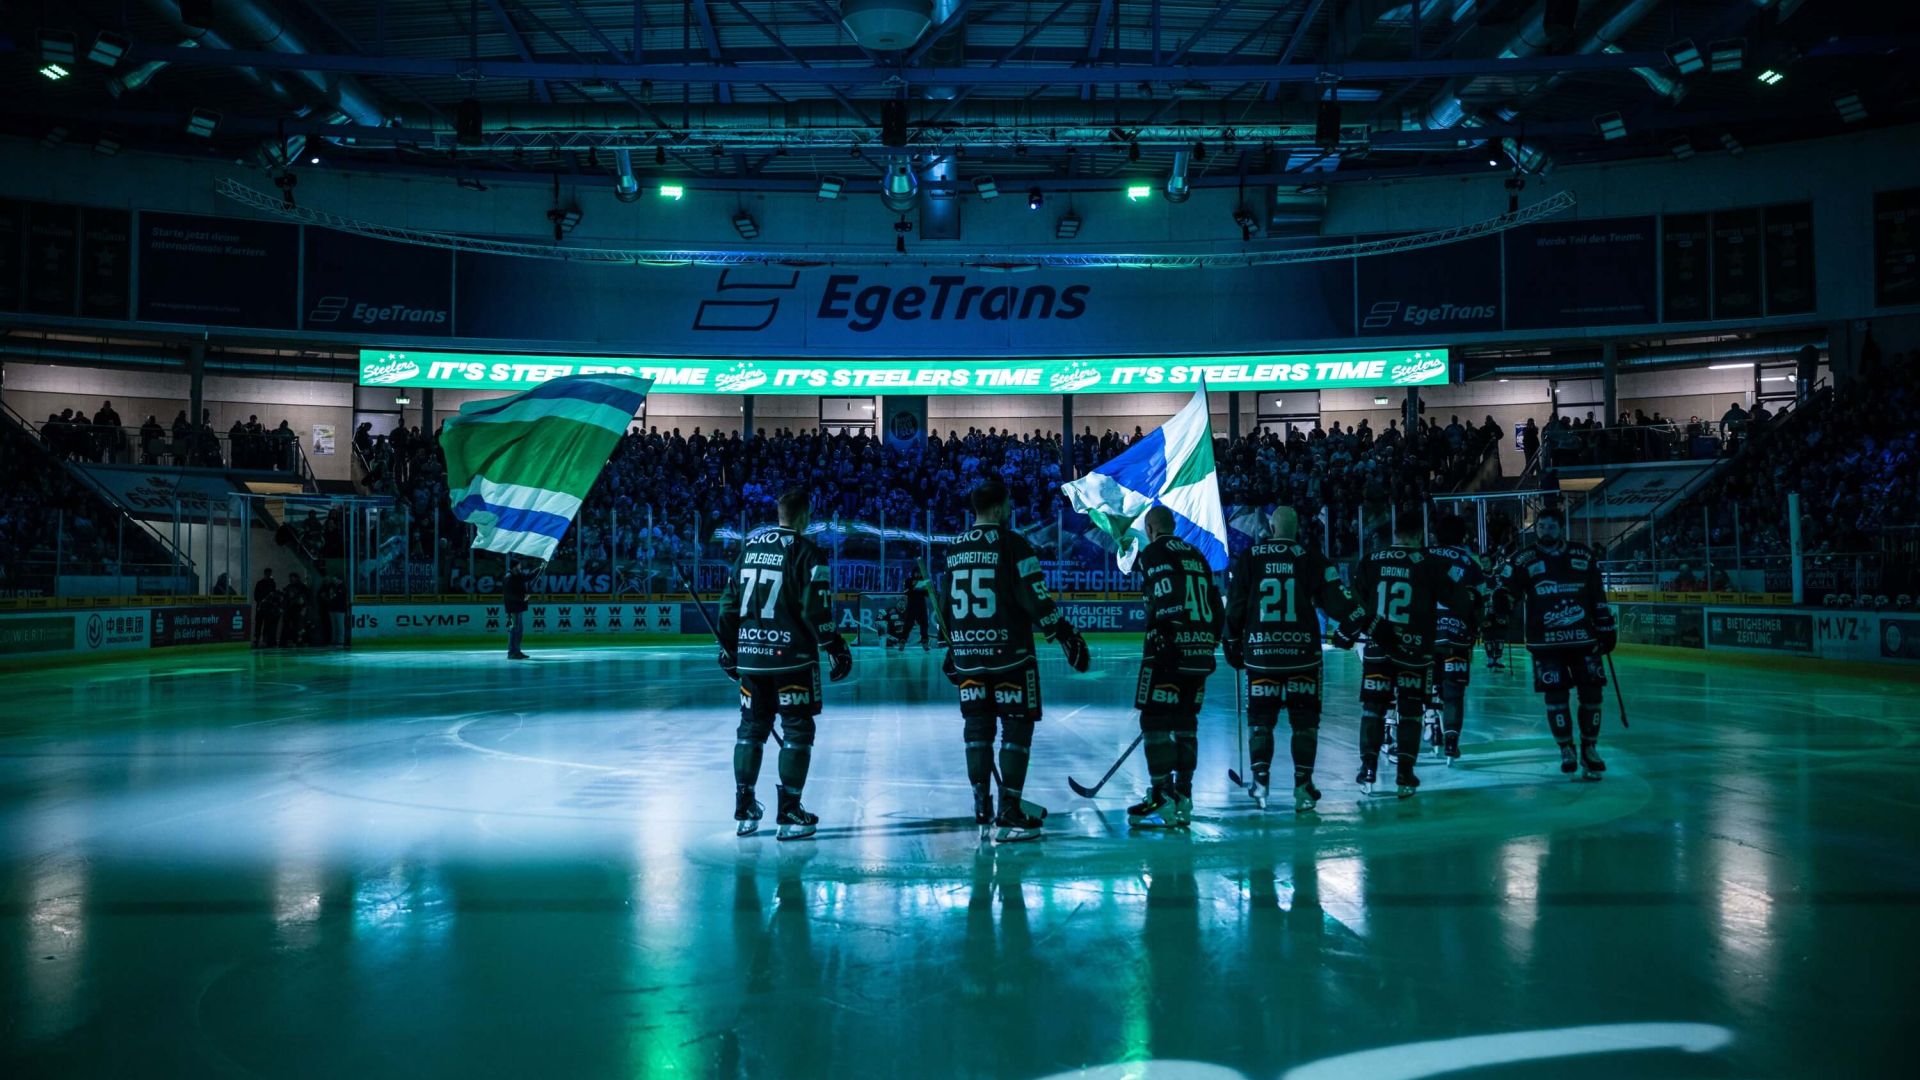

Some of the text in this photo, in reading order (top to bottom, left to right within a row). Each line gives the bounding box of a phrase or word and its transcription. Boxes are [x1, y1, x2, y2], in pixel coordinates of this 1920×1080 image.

[816, 274, 1091, 332] EgeTrans
[351, 302, 448, 324] EgeTrans
[1402, 303, 1496, 326] EgeTrans
[427, 361, 486, 381] IT'S
[639, 367, 710, 386] TIME
[773, 369, 827, 387] IT'S
[832, 368, 972, 387] STEELERS
[975, 368, 1044, 386] TIME
[1109, 366, 1166, 385] IT'S
[1168, 363, 1312, 384] STEELERS
[1315, 360, 1388, 381] TIME
[1251, 544, 1288, 557] REKO
[744, 552, 784, 567] UPLEGGER
[1265, 562, 1294, 575] STURM
[1380, 566, 1411, 579] DRONIA
[739, 568, 783, 619] 77
[950, 568, 997, 619] 55
[1154, 577, 1173, 598] 40
[1535, 584, 1558, 596] BW
[1184, 574, 1213, 624] 40
[1259, 577, 1298, 623] 21
[1376, 580, 1413, 624] 12
[1065, 604, 1123, 616] TÄGLICHES
[201, 614, 219, 624] mehr
[396, 614, 470, 627] OLYMP
[1065, 616, 1123, 629] MSPIEL.
[1727, 616, 1782, 632] BIETIGHEIMER
[738, 627, 792, 643] ACCO'S
[1248, 631, 1312, 644] ABACCO'S
[1736, 630, 1773, 645] ZEITUNG
[1253, 647, 1299, 656] STEAKHOUSE
[1444, 662, 1467, 672] BW
[1287, 680, 1317, 695] BW
[1364, 678, 1392, 692] BW
[1396, 676, 1422, 689] BW
[960, 686, 986, 702] BW
[994, 688, 1023, 704] BW
[1250, 684, 1280, 697] BW
[778, 691, 810, 706] BW
